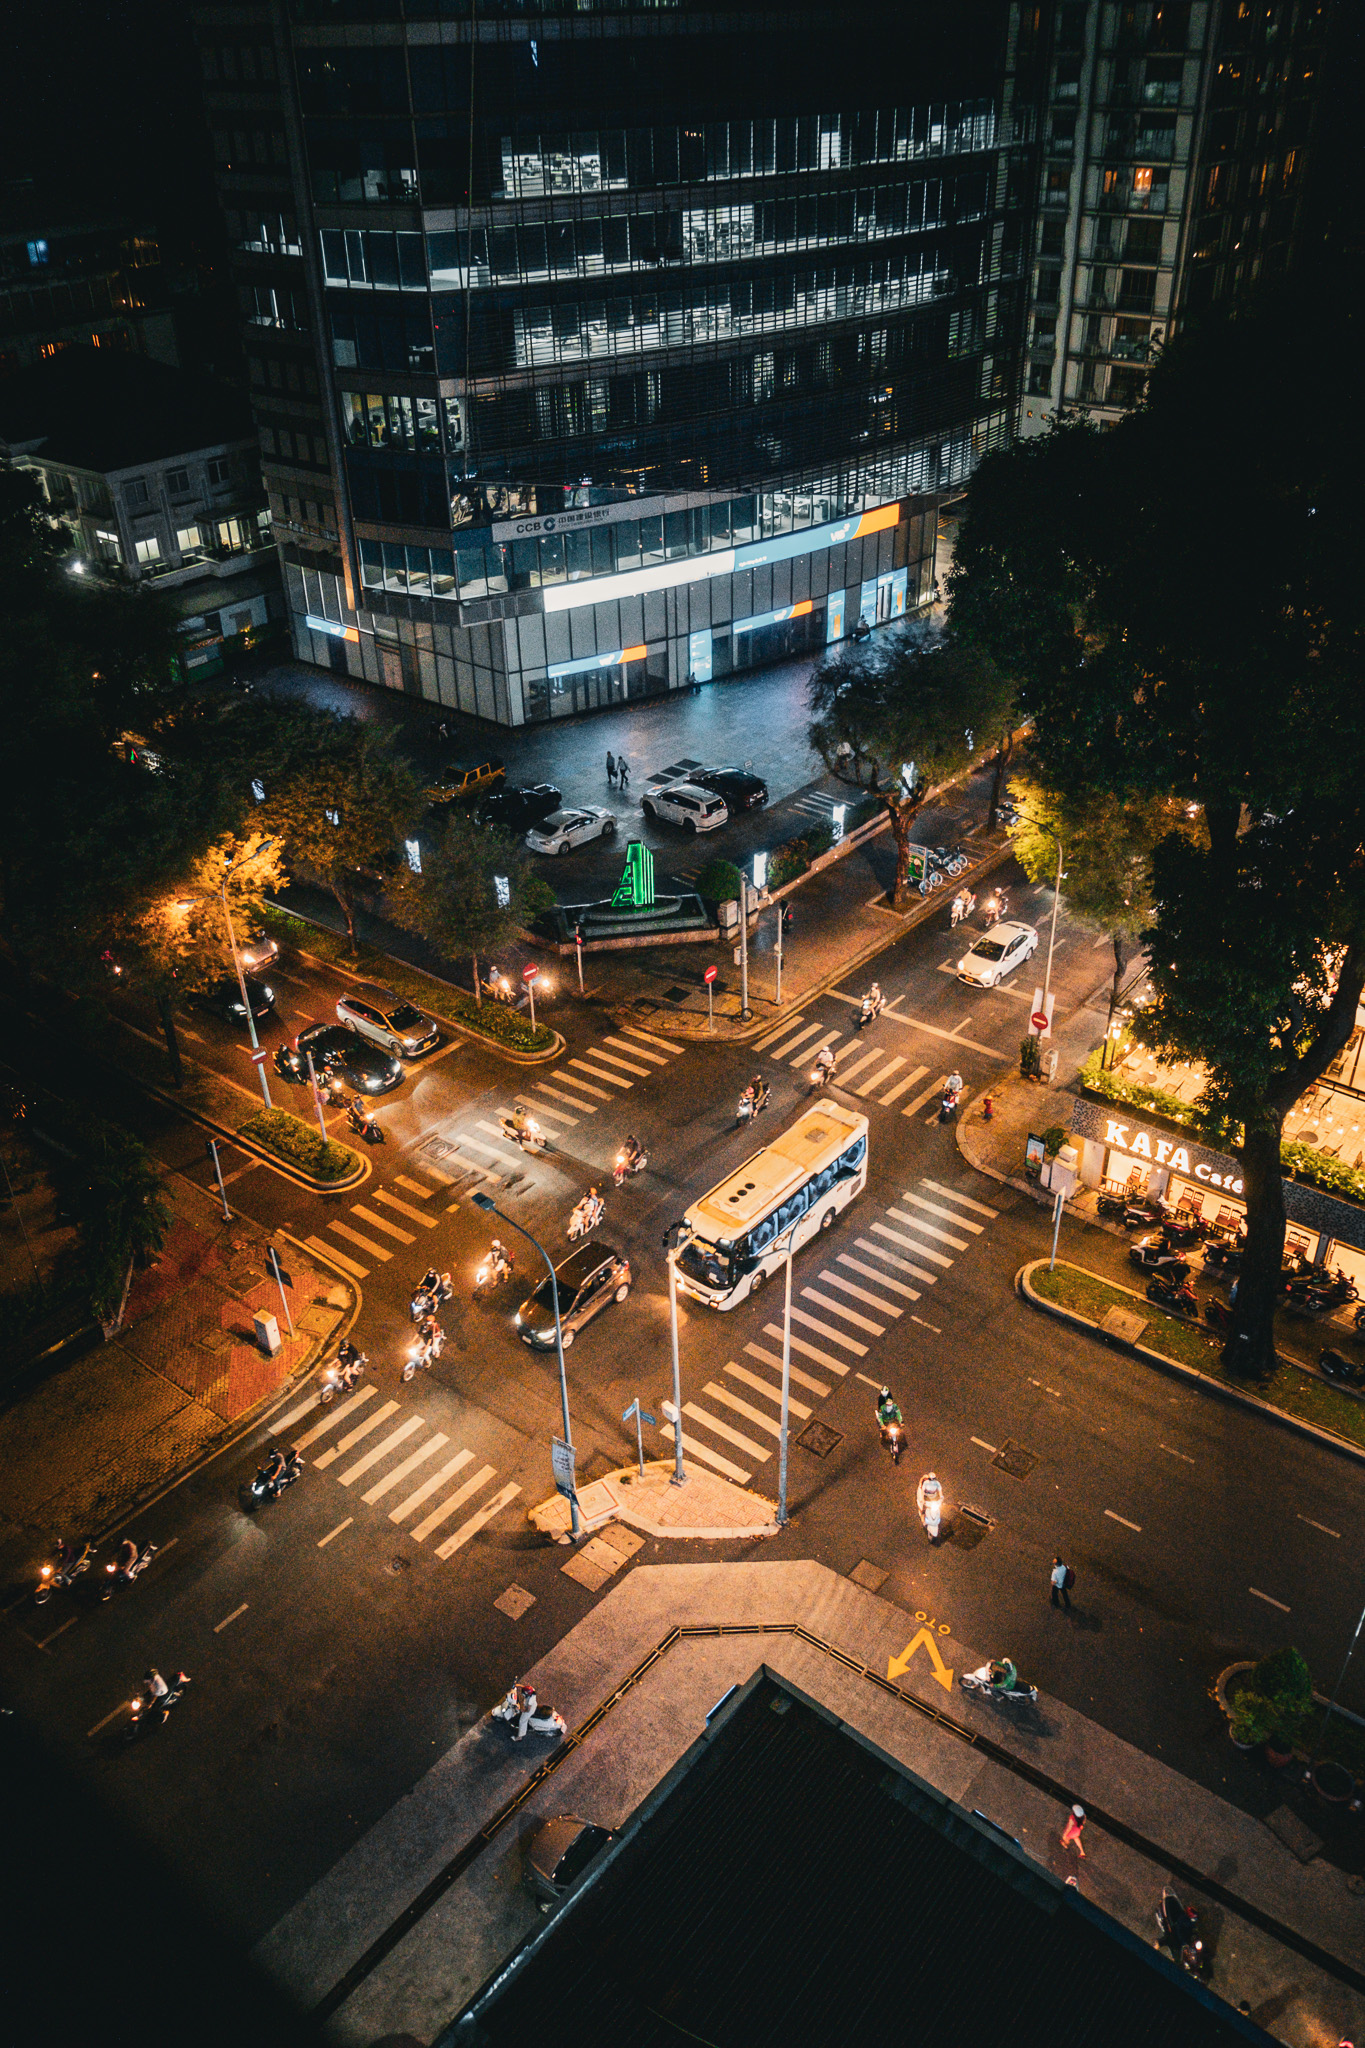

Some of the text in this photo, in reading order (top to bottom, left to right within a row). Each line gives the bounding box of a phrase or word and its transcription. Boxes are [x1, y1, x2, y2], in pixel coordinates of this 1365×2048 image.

[516, 522, 542, 534] CCB
[1103, 1119, 1244, 1194] KAFA Café
